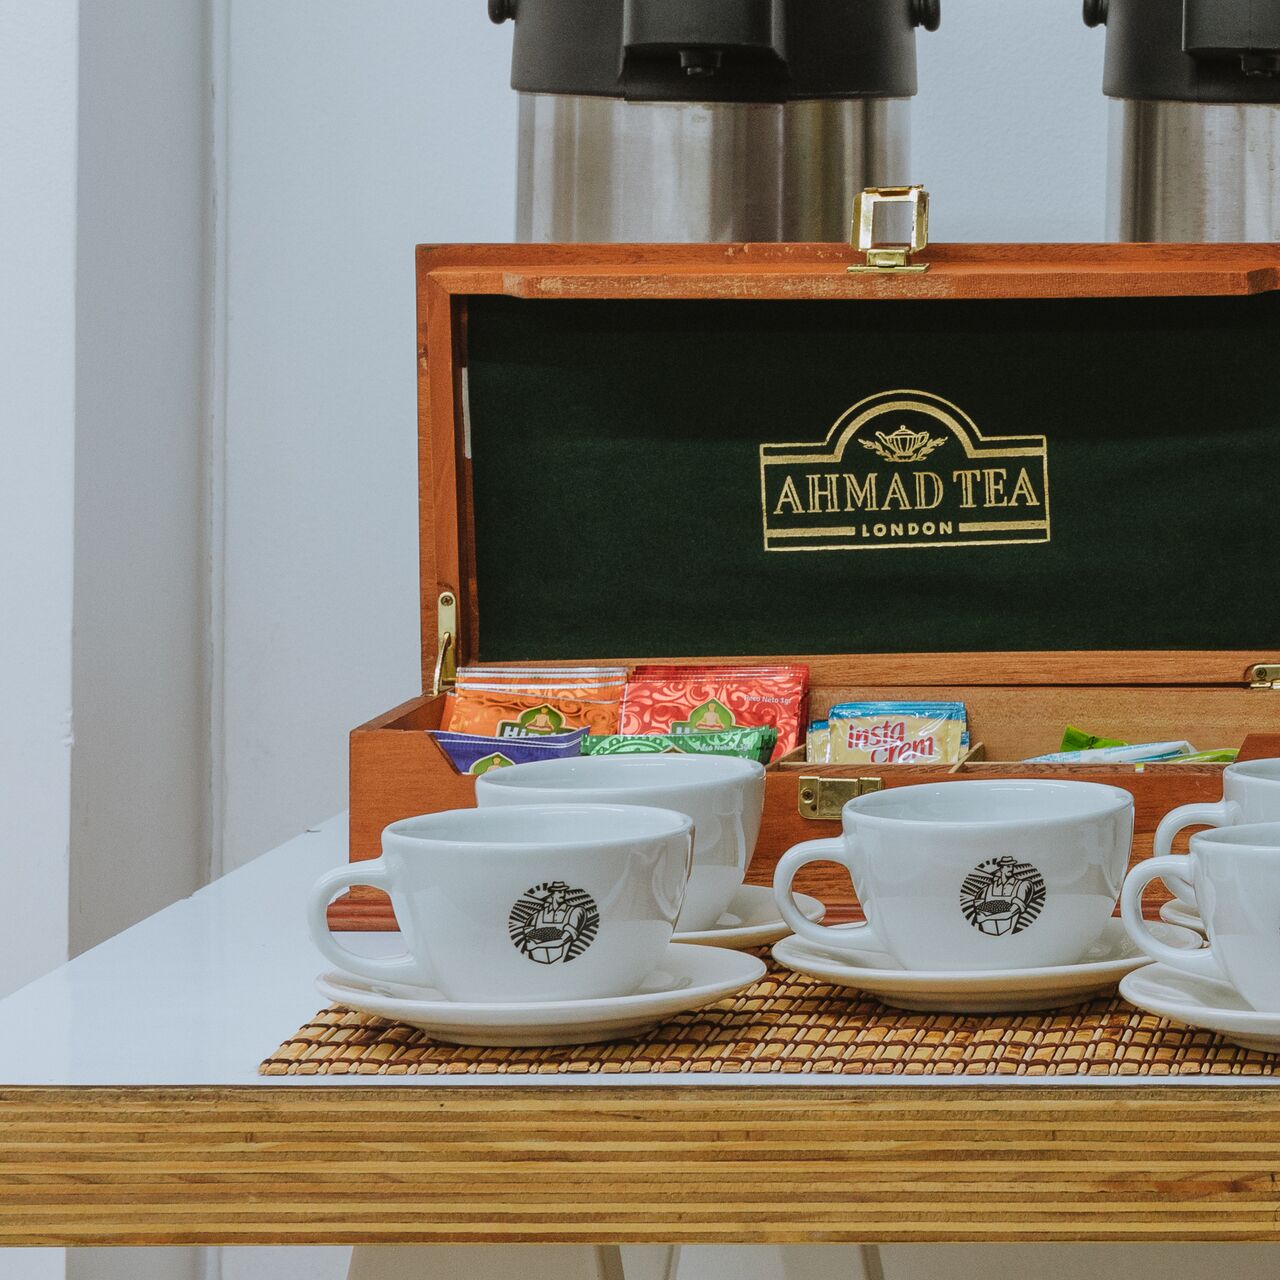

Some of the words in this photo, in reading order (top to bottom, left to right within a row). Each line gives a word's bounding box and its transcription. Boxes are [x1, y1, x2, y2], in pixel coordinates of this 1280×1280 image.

[773, 471, 944, 514] AHMAD
[953, 468, 1040, 508] TEA
[862, 521, 953, 538] LONDON
[762, 696, 779, 704] Neto
[847, 720, 905, 749] insta
